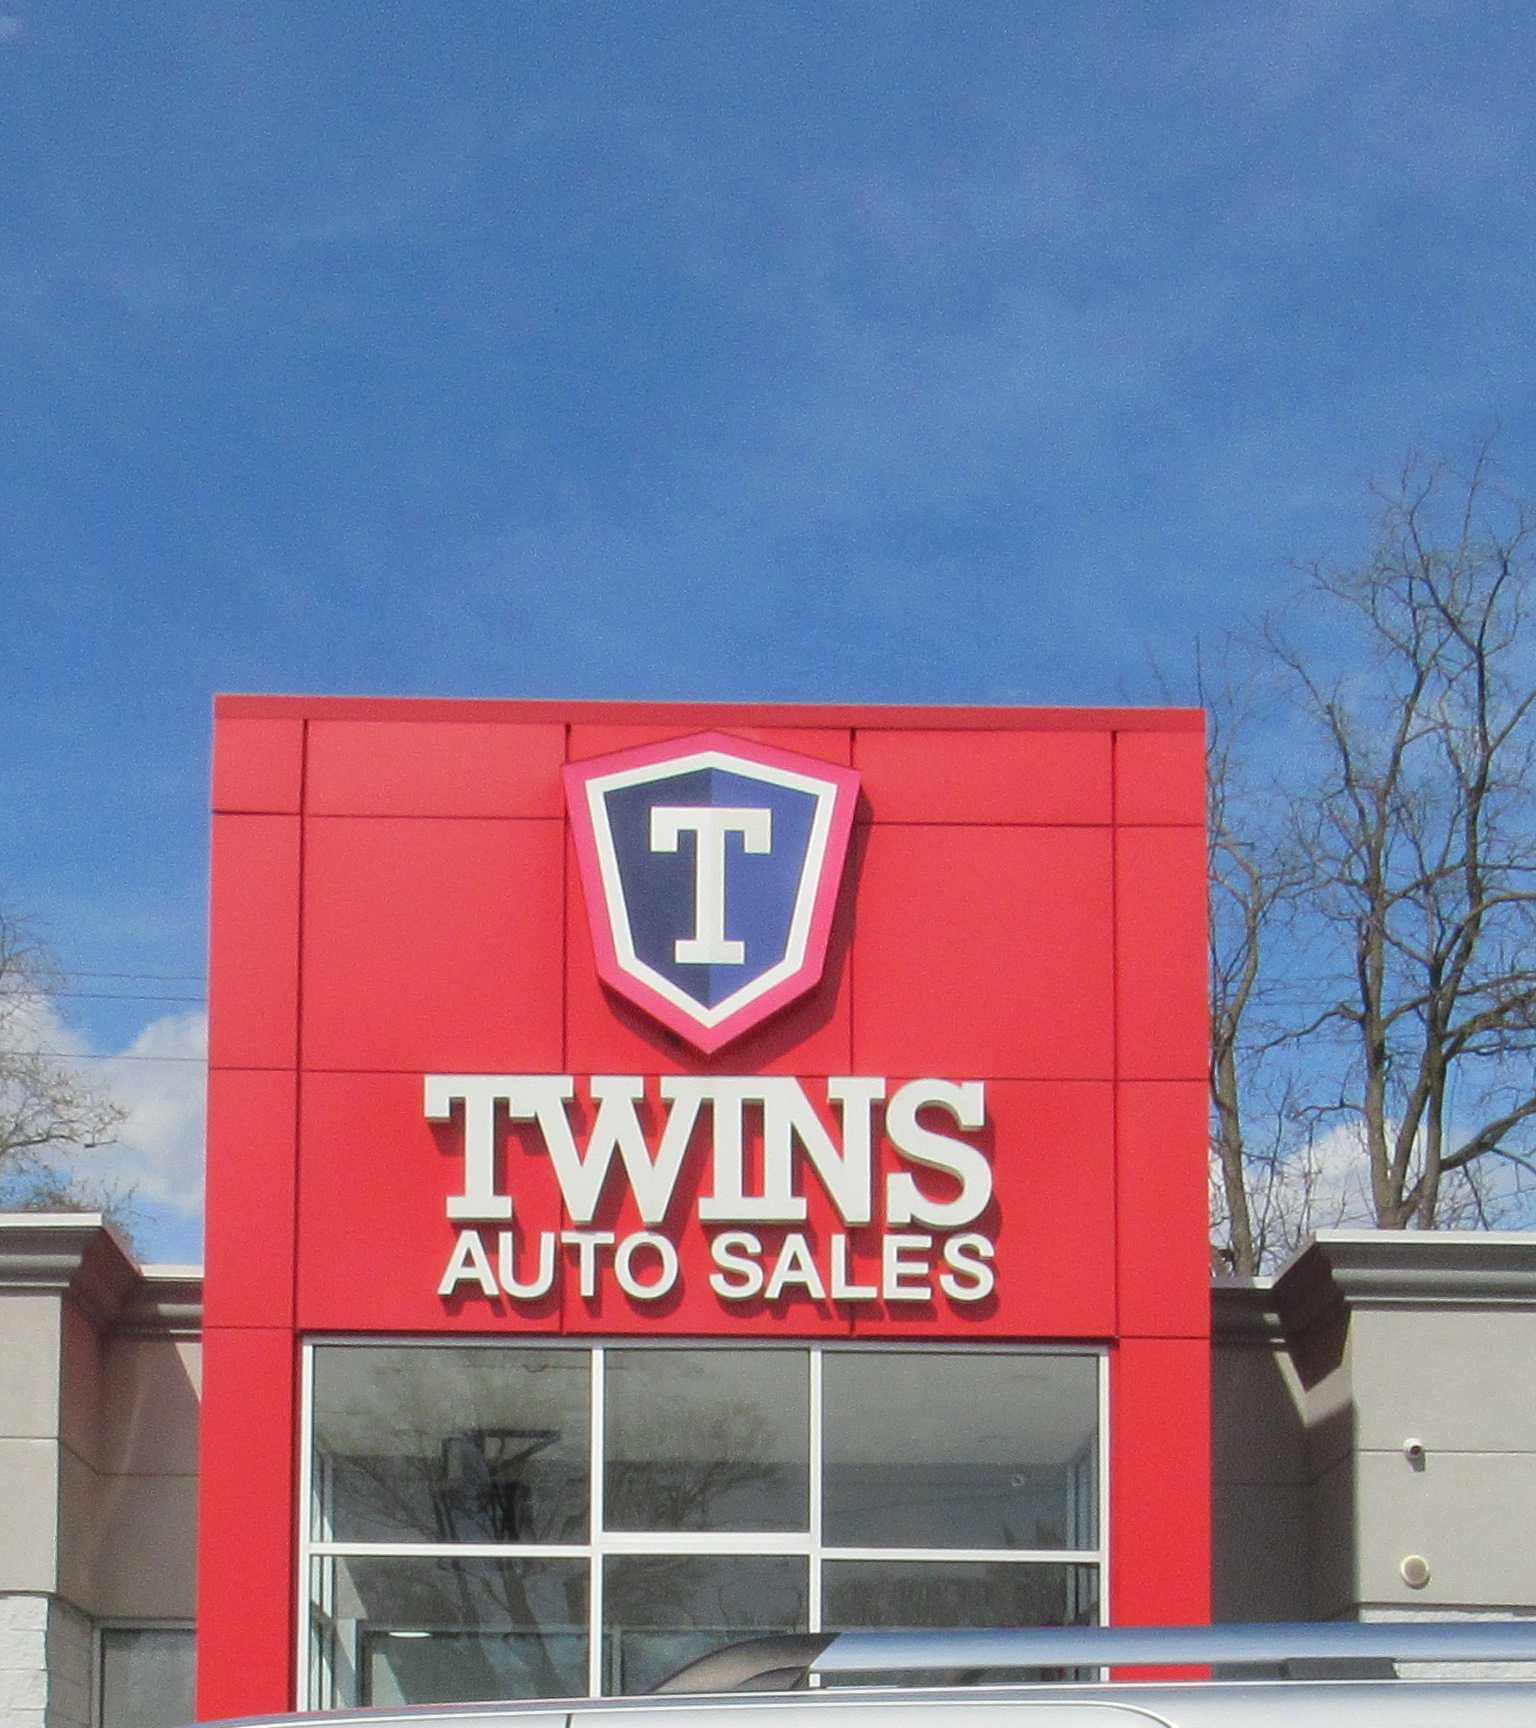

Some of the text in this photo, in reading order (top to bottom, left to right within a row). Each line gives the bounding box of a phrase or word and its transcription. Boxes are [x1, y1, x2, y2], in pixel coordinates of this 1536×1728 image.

[650, 806, 772, 965] T
[424, 1075, 994, 1228] TWINS
[437, 1230, 995, 1303] AUTO SALES
